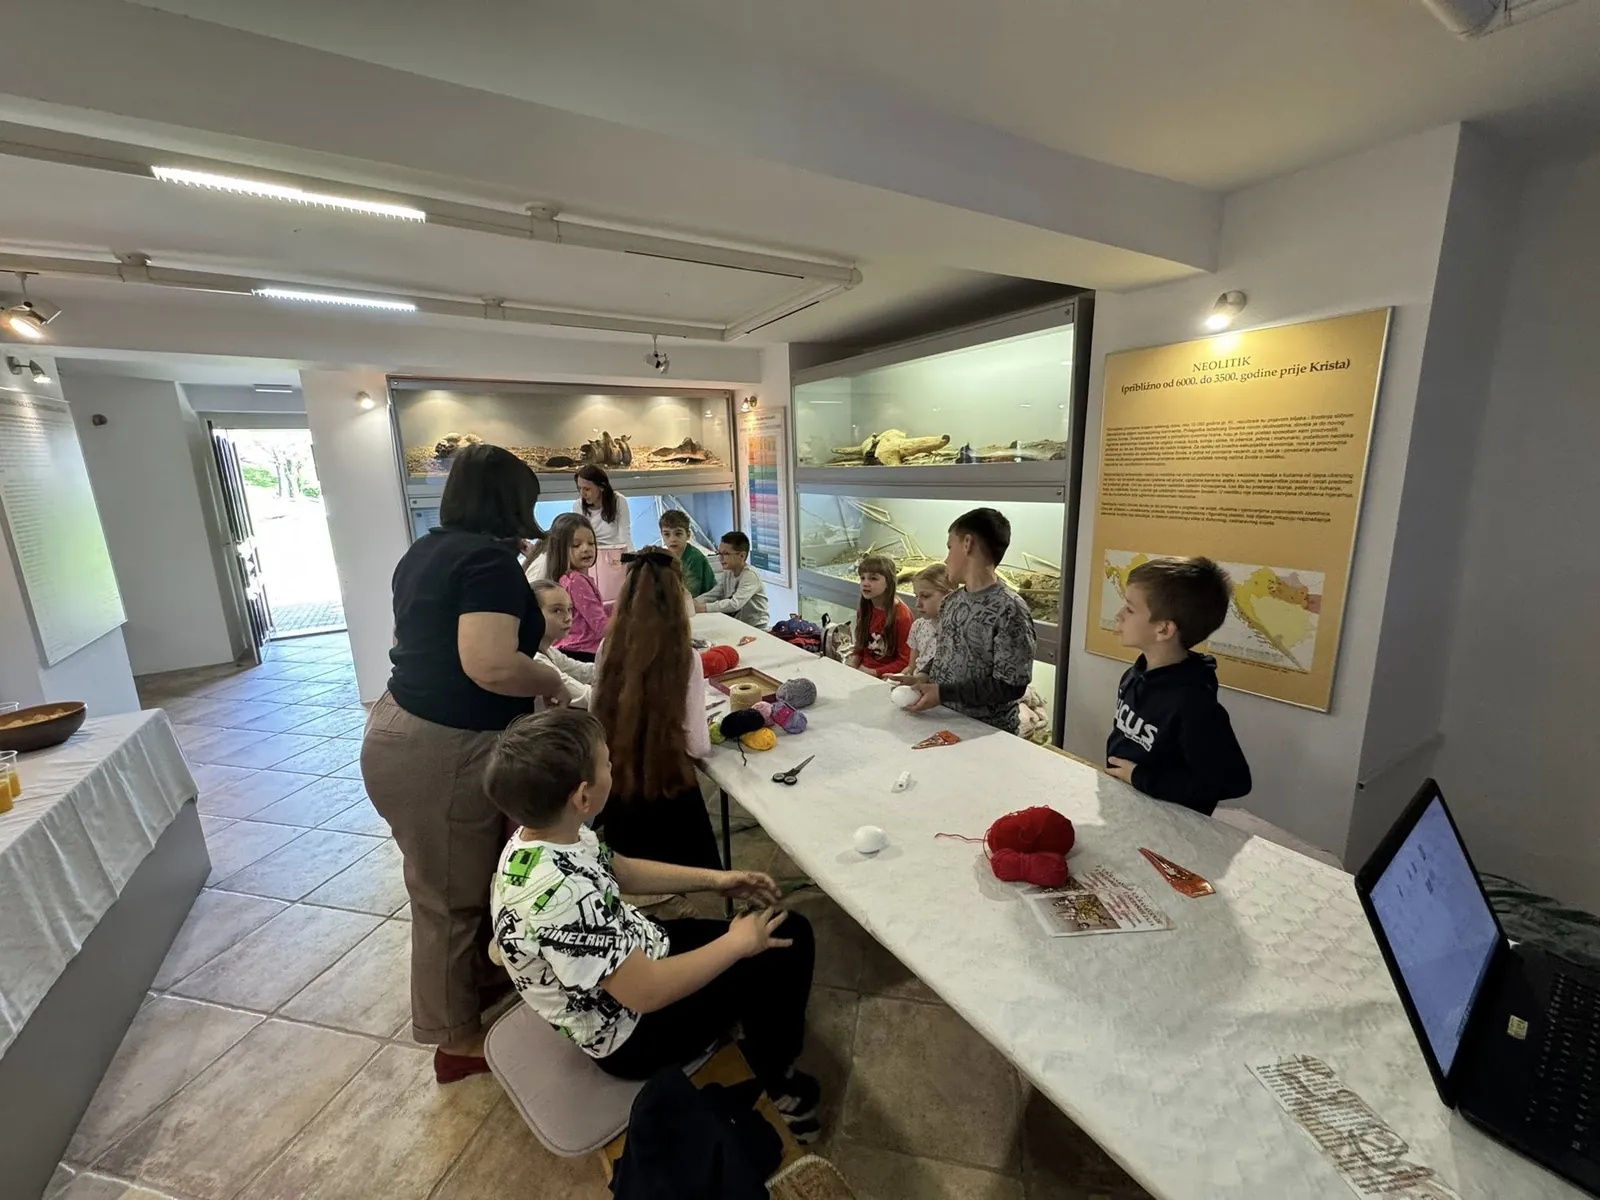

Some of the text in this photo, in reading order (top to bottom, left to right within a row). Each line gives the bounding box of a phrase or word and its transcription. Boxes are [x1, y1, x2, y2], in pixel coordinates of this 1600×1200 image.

[1192, 356, 1251, 372] NEOLITIK
[1121, 358, 1350, 395] (približno od 6000. do 3500. godine prije Krista)
[537, 928, 623, 948] MINECRAFT
